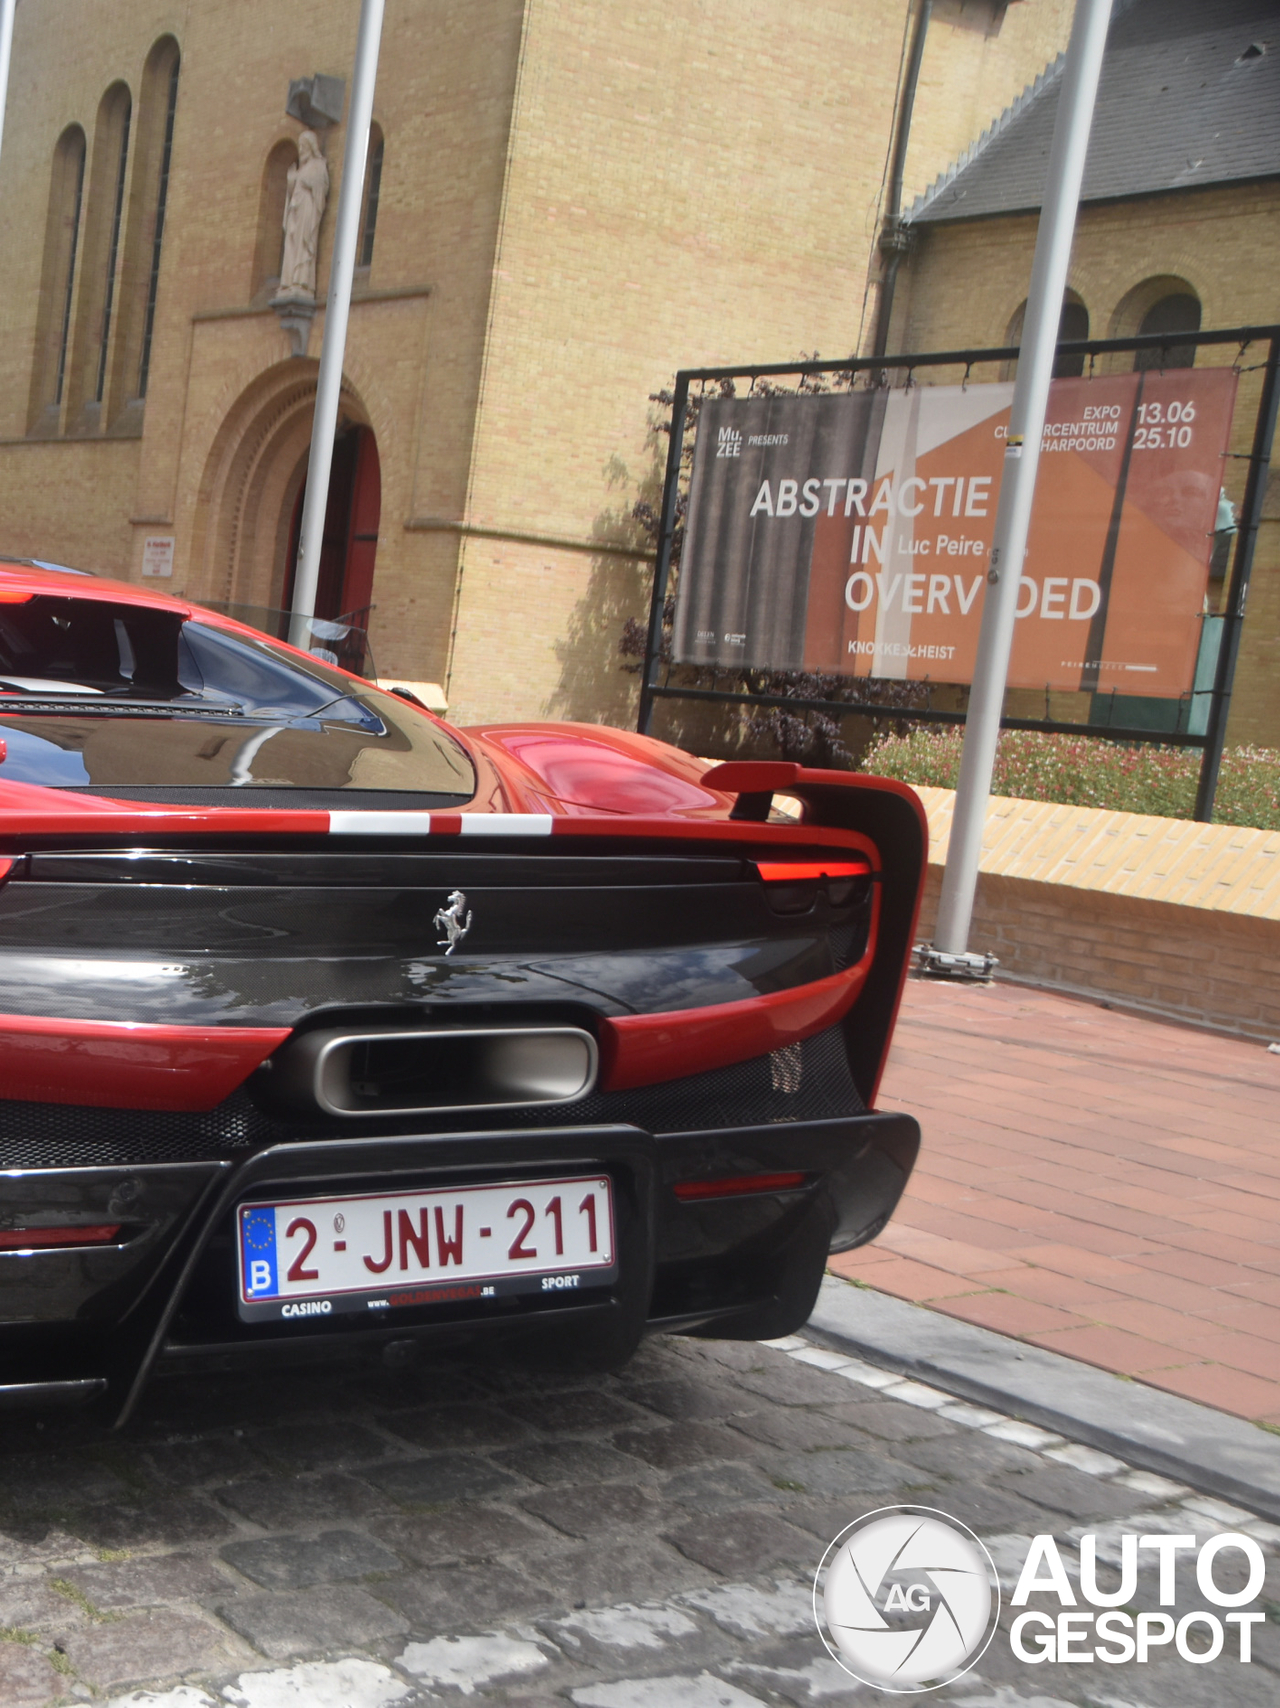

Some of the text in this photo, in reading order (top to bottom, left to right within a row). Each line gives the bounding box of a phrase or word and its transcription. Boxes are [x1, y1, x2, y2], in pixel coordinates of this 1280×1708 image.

[1083, 401, 1196, 424] EXPO 13.06
[716, 442, 741, 458] ZEE
[748, 434, 789, 446] PRESENTS
[1132, 426, 1193, 449] 25.10
[749, 476, 992, 517] ABSTRACTIE
[850, 525, 890, 564] IN
[898, 535, 931, 555] Luc
[936, 535, 984, 556] Peire
[845, 571, 1101, 620] OVERVOED
[251, 1259, 271, 1291] B
[281, 1301, 332, 1317] CASINO
[541, 1274, 580, 1290] SPORT
